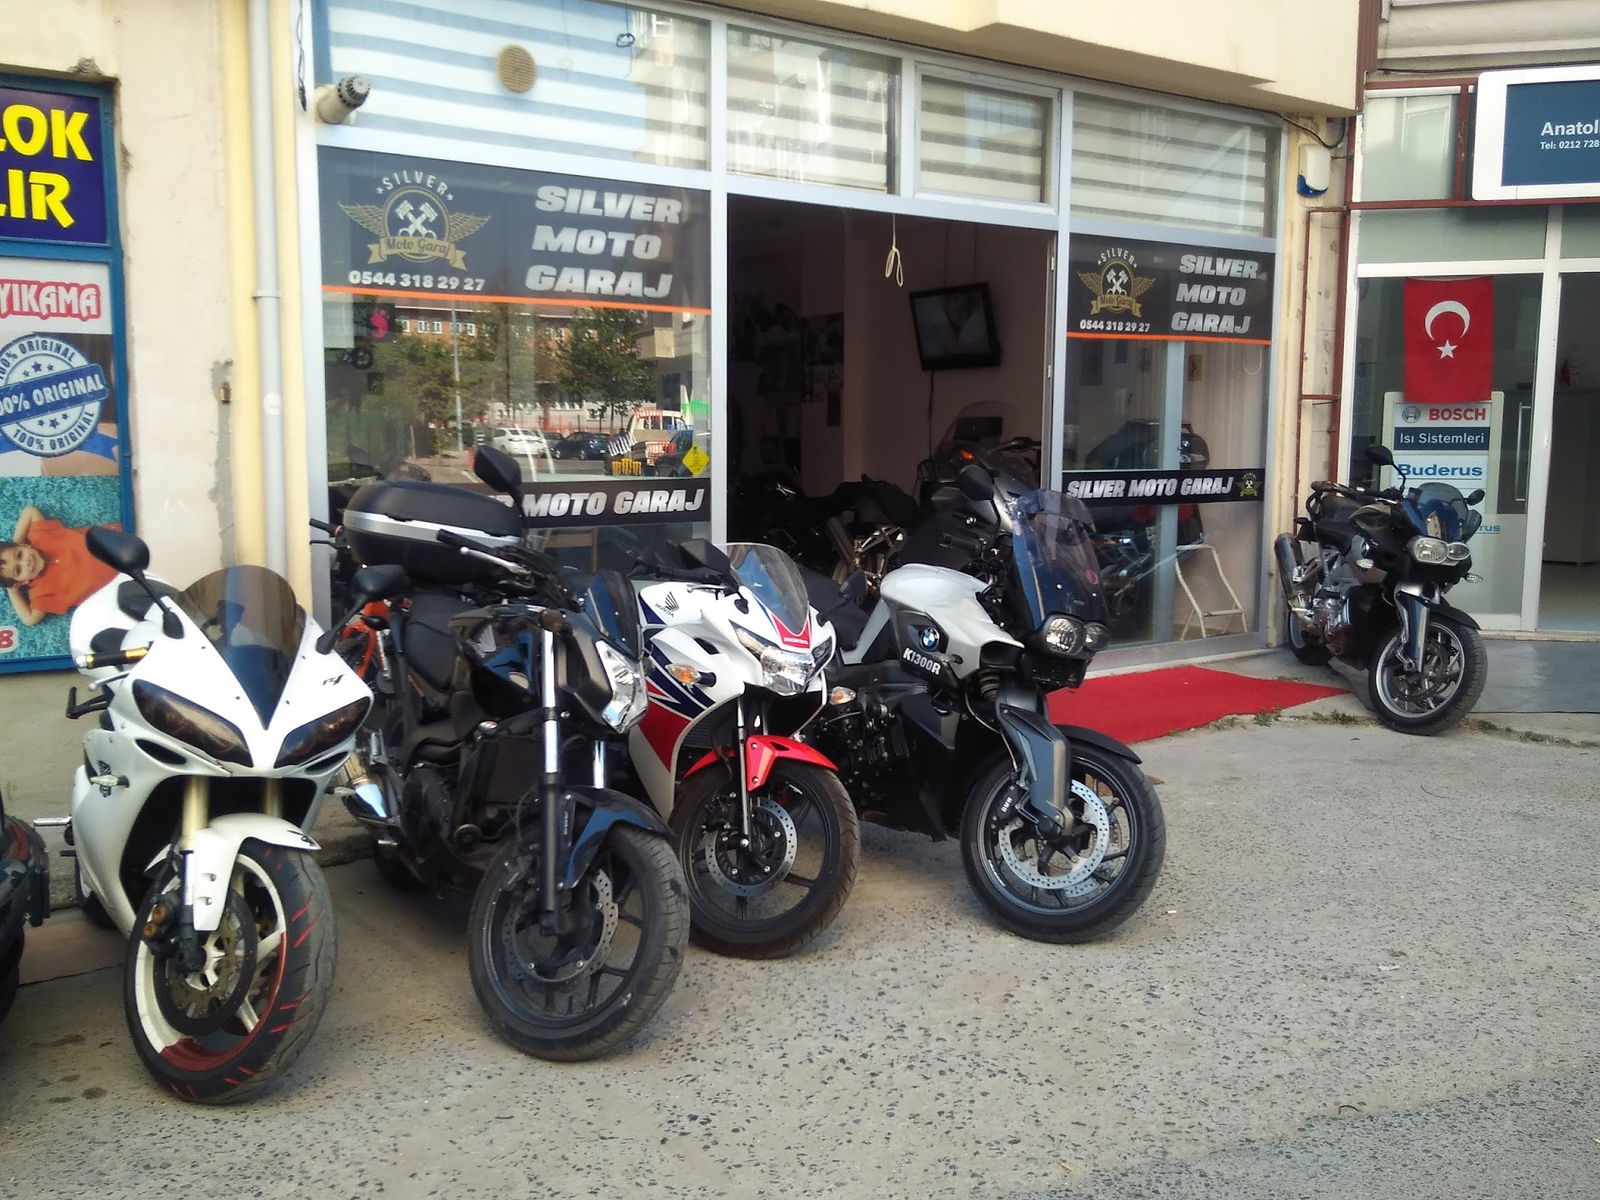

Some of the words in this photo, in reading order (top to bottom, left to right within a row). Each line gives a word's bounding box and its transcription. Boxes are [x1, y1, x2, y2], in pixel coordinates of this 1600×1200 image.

[0, 104, 94, 161] OK
[1541, 119, 1600, 136] Anatol
[1540, 141, 1557, 150] Tel:
[1559, 140, 1581, 149] 0212
[1583, 139, 1600, 148] 728
[381, 170, 448, 195] SILVER
[0, 169, 75, 228] IR
[535, 185, 682, 224] SILVER
[532, 225, 662, 260] MOTO
[1100, 247, 1135, 265] SILVER
[1179, 254, 1259, 279] SILVER
[349, 270, 396, 286] 0544
[400, 273, 434, 288] 318
[437, 275, 460, 290] 29
[463, 278, 485, 291] 27
[525, 265, 673, 298] GARAJ
[1175, 283, 1246, 306] MOTO
[1080, 319, 1105, 330] 0544
[1106, 320, 1124, 331] 318
[1125, 321, 1138, 332] 29
[1139, 322, 1150, 332] 27
[1171, 311, 1251, 334] GARAJ
[18, 339, 76, 362] ORIGINAL
[32, 374, 104, 407] ORIGINAL
[1428, 408, 1487, 421] BOSCH
[13, 428, 45, 451] 100%
[49, 411, 95, 451] ORIGINAL
[1418, 432, 1485, 444] Sistemleri
[1398, 463, 1483, 477] Buderus
[1067, 479, 1126, 499] SILVER
[1128, 478, 1176, 497] MOTO
[1180, 476, 1234, 496] GARAJ
[522, 491, 607, 518] MOTO
[613, 488, 705, 515] GARAJ
[903, 647, 941, 675] K1300R
